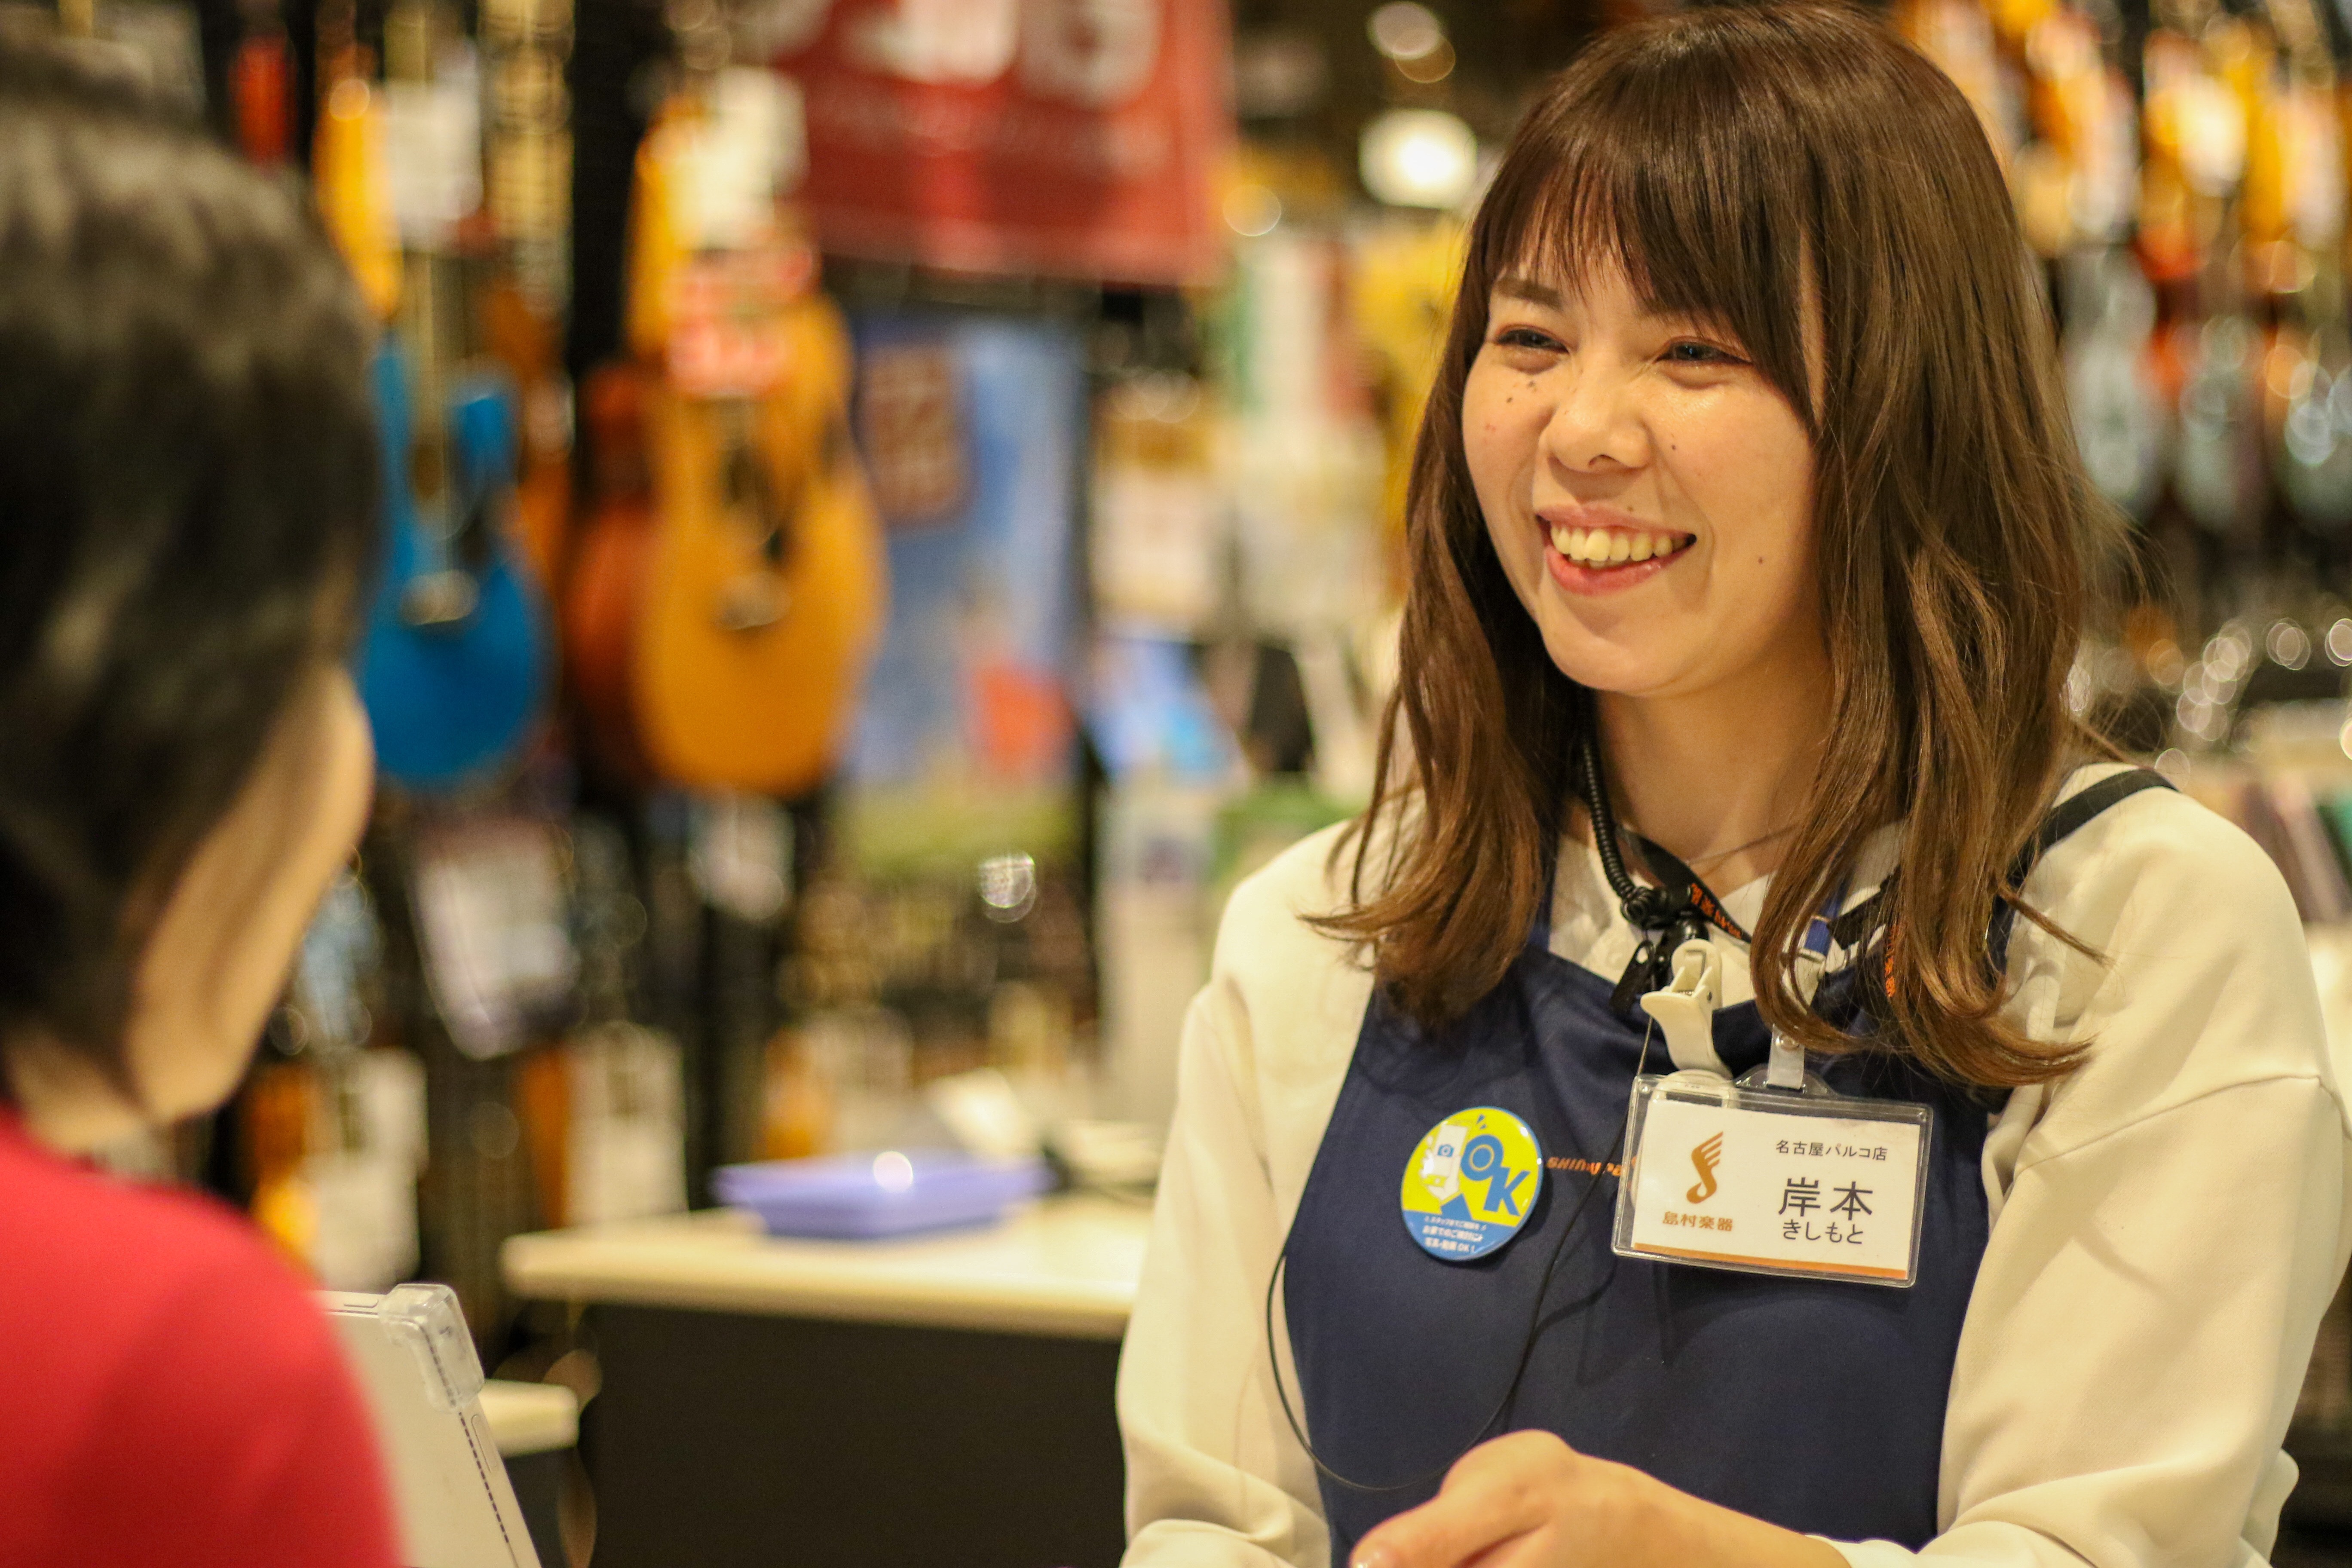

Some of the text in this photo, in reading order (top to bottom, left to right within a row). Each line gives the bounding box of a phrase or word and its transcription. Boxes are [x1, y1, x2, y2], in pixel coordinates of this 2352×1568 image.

[1776, 1139, 1888, 1161] 名古屋パルコ店
[1460, 1134, 1531, 1216] OK
[1778, 1176, 1873, 1220] 岸本
[1663, 1211, 1734, 1231] 島村楽器
[1783, 1219, 1863, 1244] きしもと
